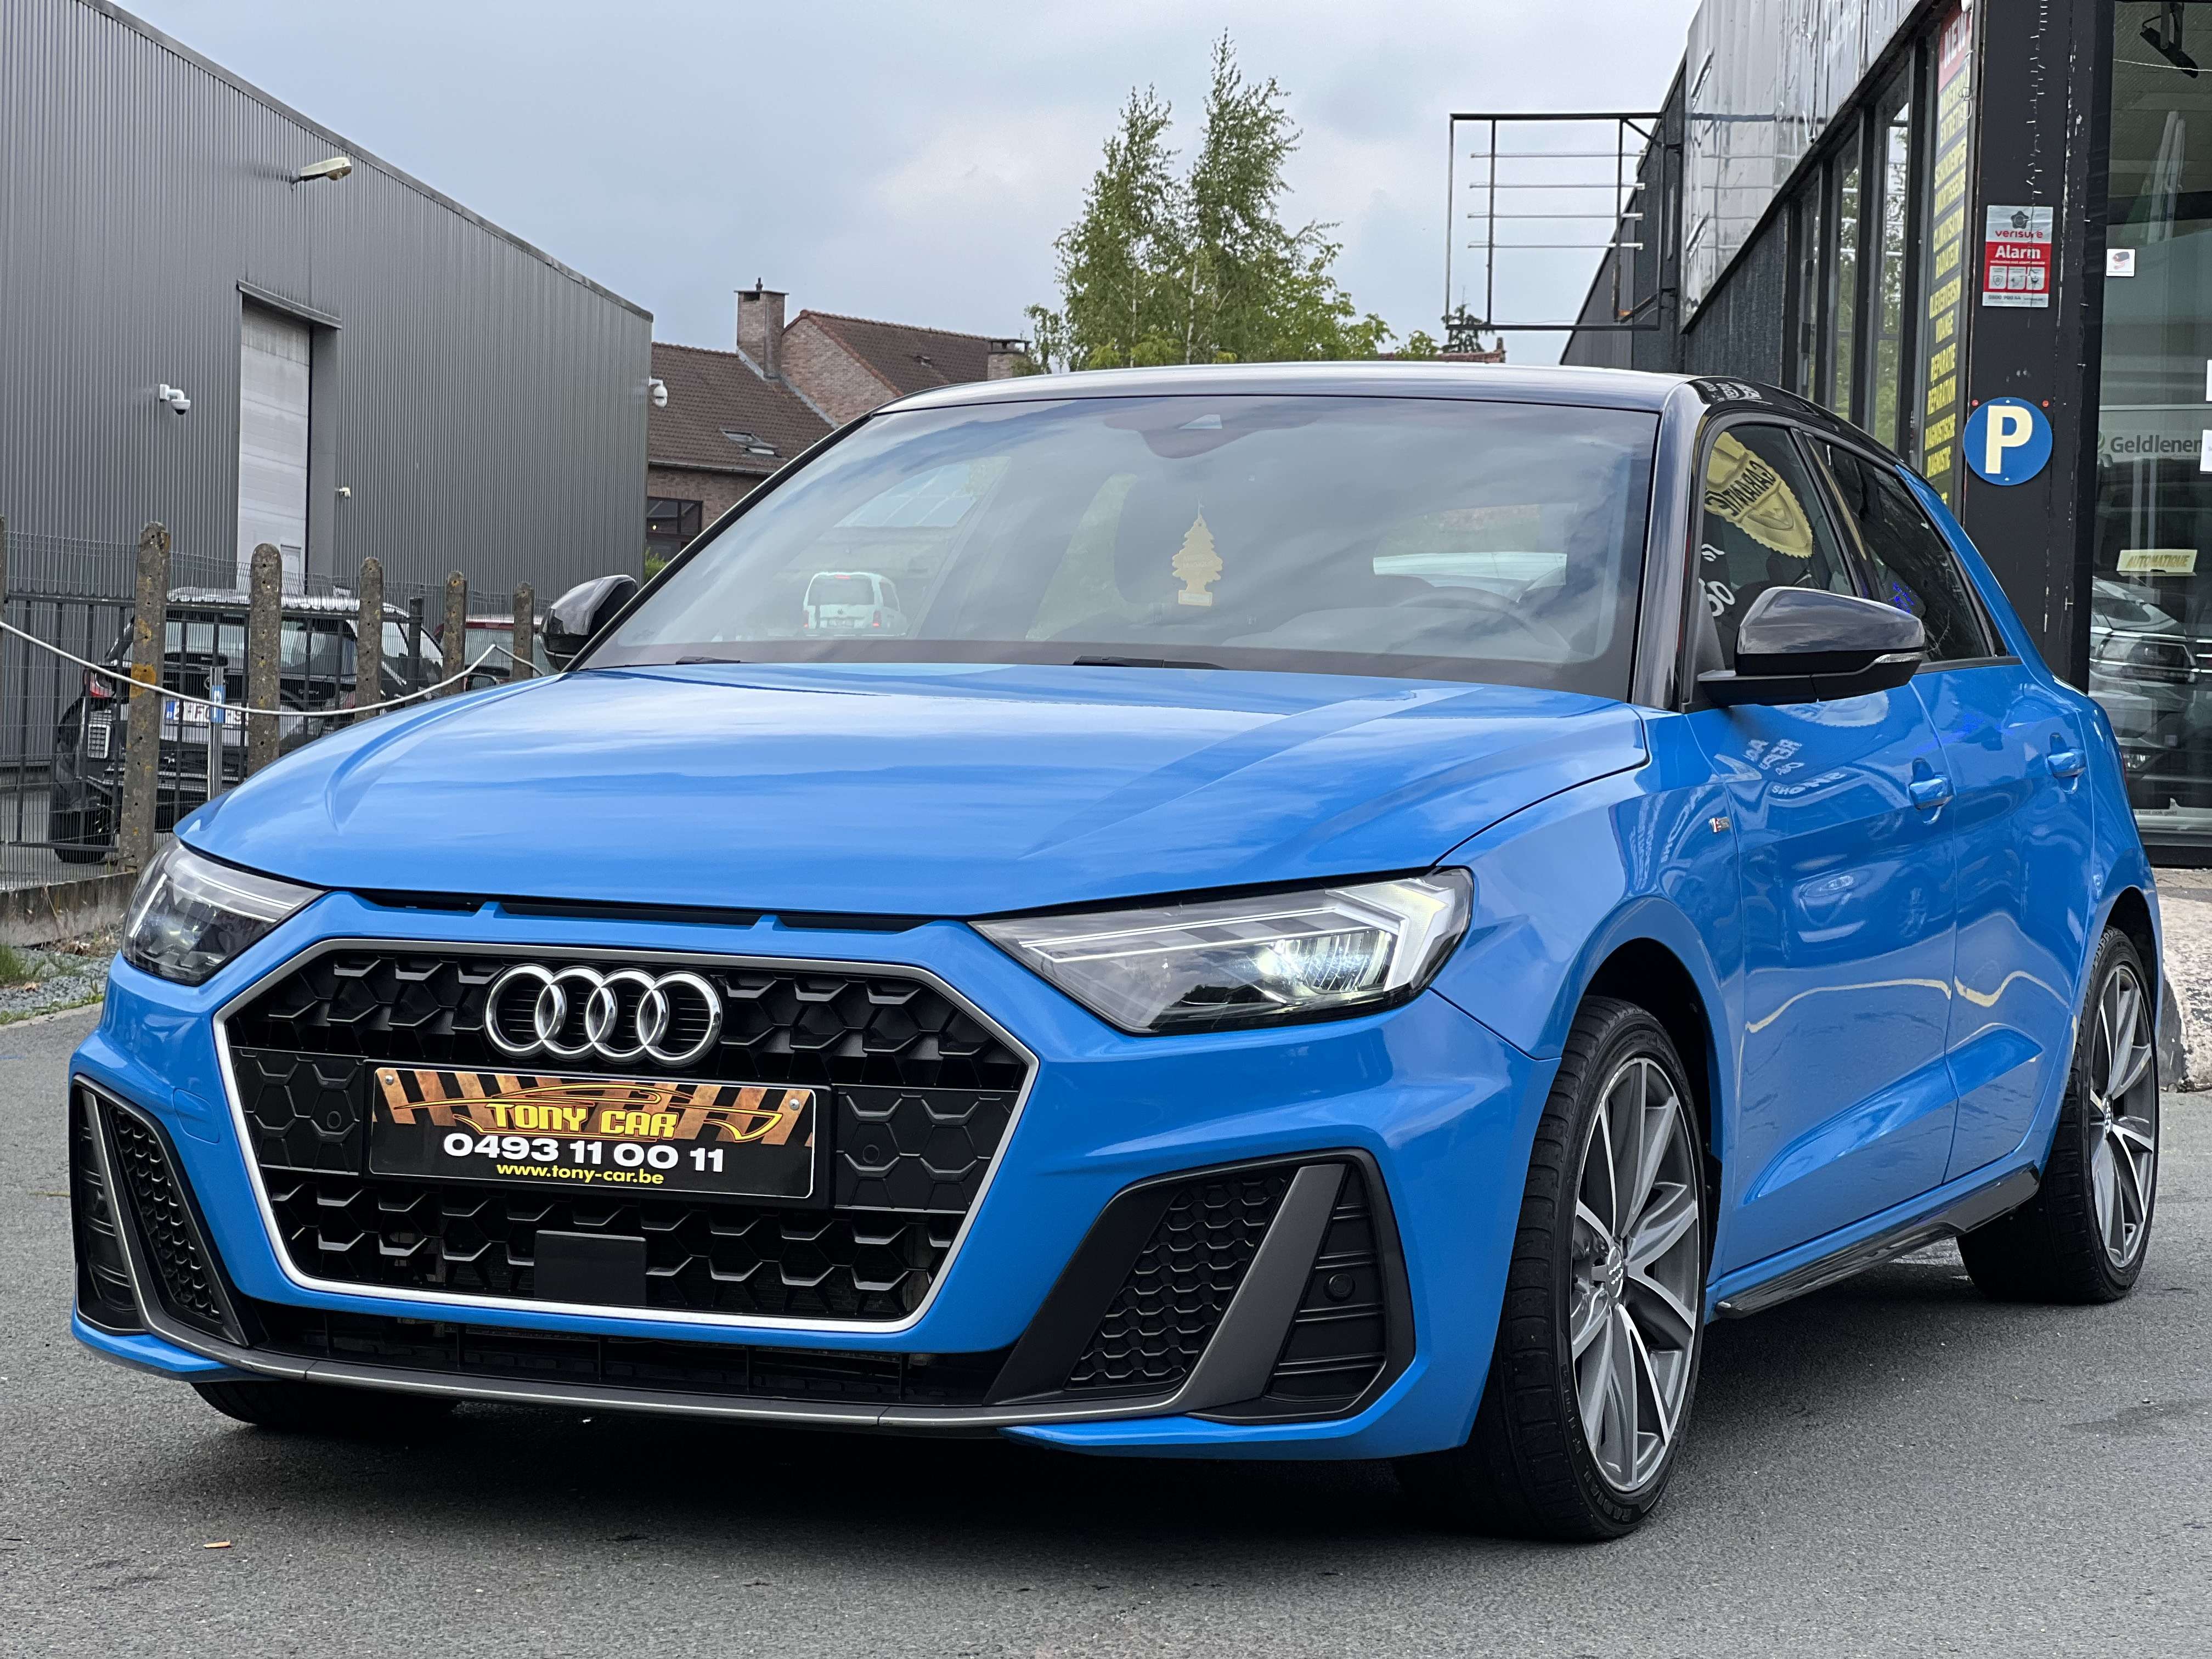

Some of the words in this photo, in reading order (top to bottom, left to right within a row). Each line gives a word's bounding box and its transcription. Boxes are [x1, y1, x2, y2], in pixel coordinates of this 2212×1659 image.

[1995, 245, 2041, 259] Alarm
[1985, 405, 2032, 473] P
[2126, 555, 2190, 568] AUTOMATIQUE
[486, 1103, 587, 1132] TONY
[601, 1110, 678, 1138] CAR
[443, 1133, 558, 1162] 0493
[570, 1140, 602, 1164] 11
[613, 1143, 678, 1169] 00
[690, 1148, 724, 1172] 11
[496, 1164, 664, 1184] www.tony-car.be
